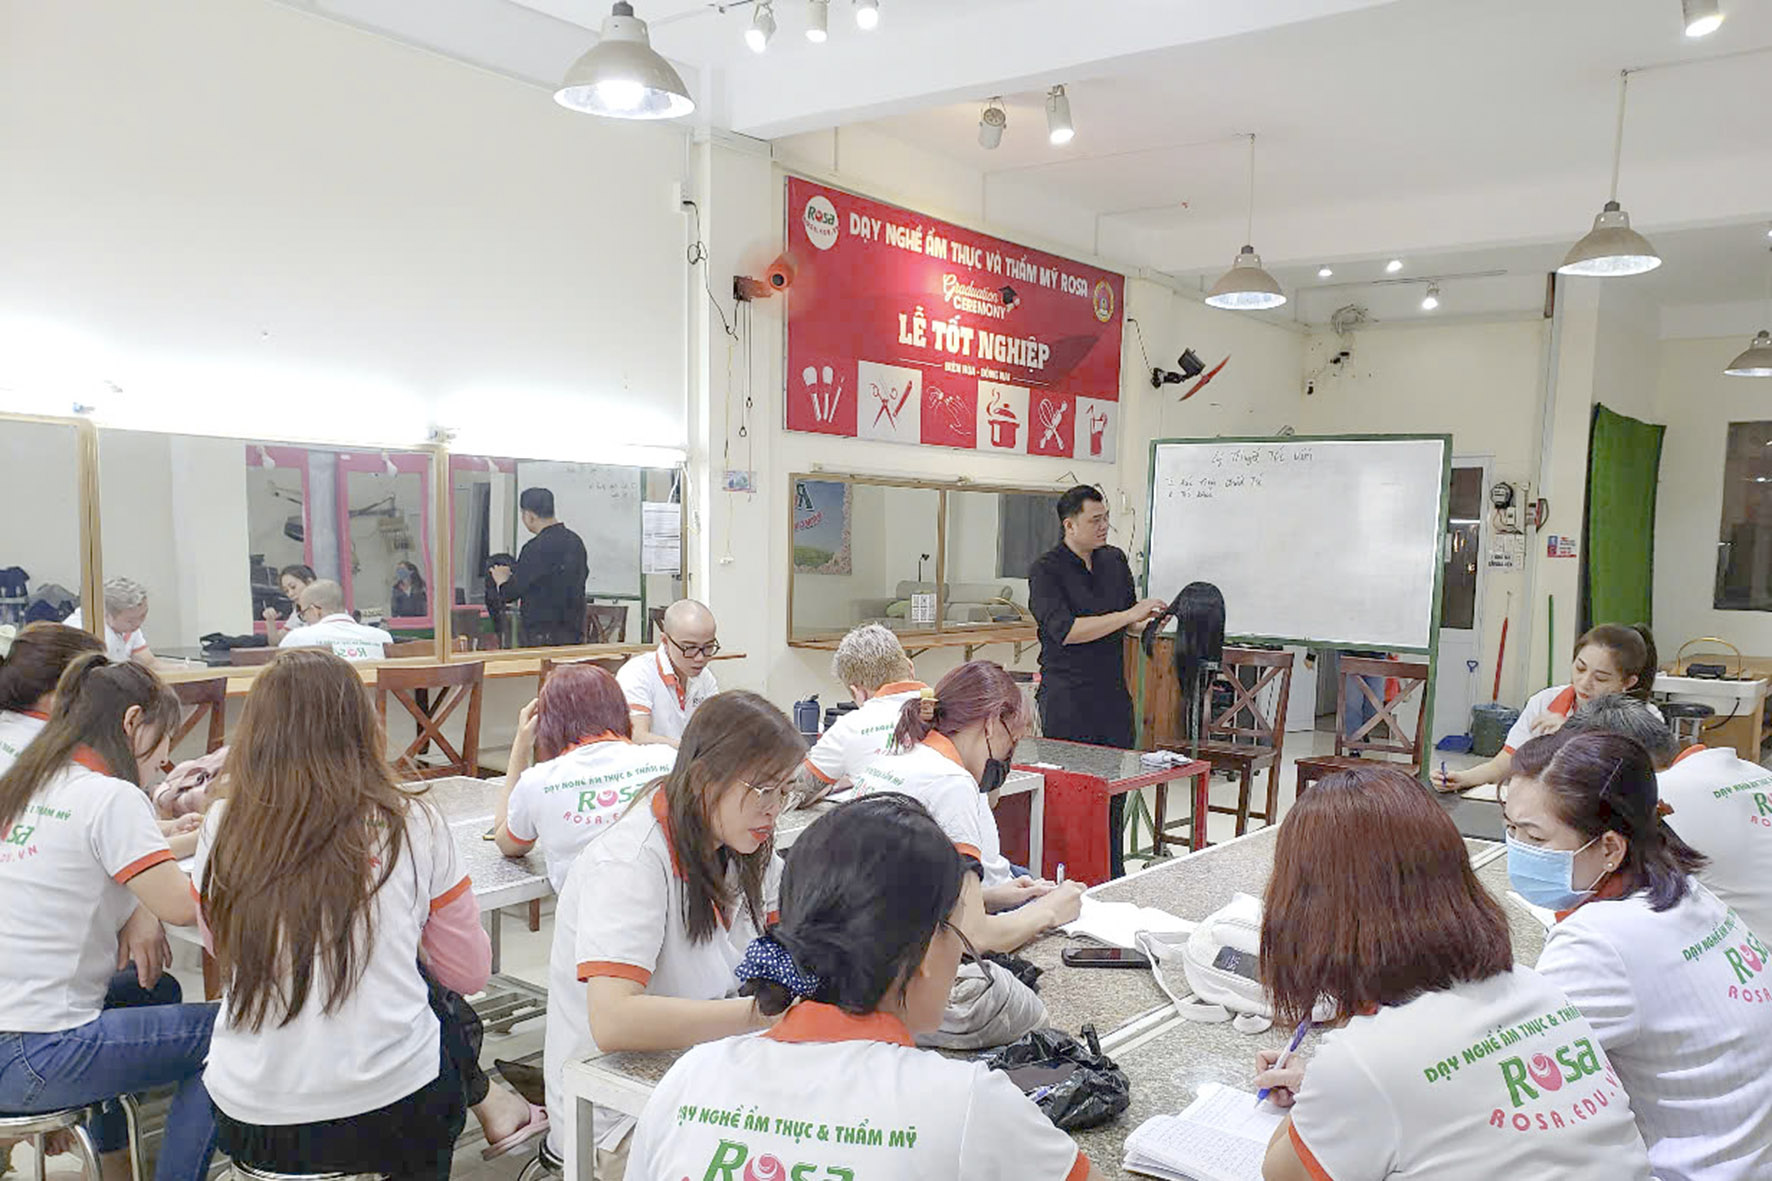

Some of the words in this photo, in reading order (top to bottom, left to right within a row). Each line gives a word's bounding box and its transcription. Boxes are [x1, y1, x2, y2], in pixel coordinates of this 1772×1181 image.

[807, 206, 835, 226] Rosa
[850, 212, 881, 243] DẠY
[986, 250, 1002, 275] VÀ
[1005, 254, 1037, 284] THẨM
[1061, 273, 1088, 297] ROSA
[943, 274, 999, 303] Graduation
[953, 296, 1006, 320] CEREMONY
[898, 305, 927, 348] LỄ
[931, 314, 974, 356] TỐT
[978, 330, 1050, 373] NGHIỆP
[1423, 1055, 1459, 1083] DẠY
[1462, 1030, 1501, 1064] NGHỀ
[1546, 1013, 1559, 1026] &
[1498, 1036, 1602, 1109] Rosa
[699, 1104, 744, 1128] NGHỀ
[744, 1105, 770, 1133] ẨM
[817, 1124, 829, 1141] &
[835, 1118, 883, 1146] THẨM
[889, 1126, 918, 1149] MỸ
